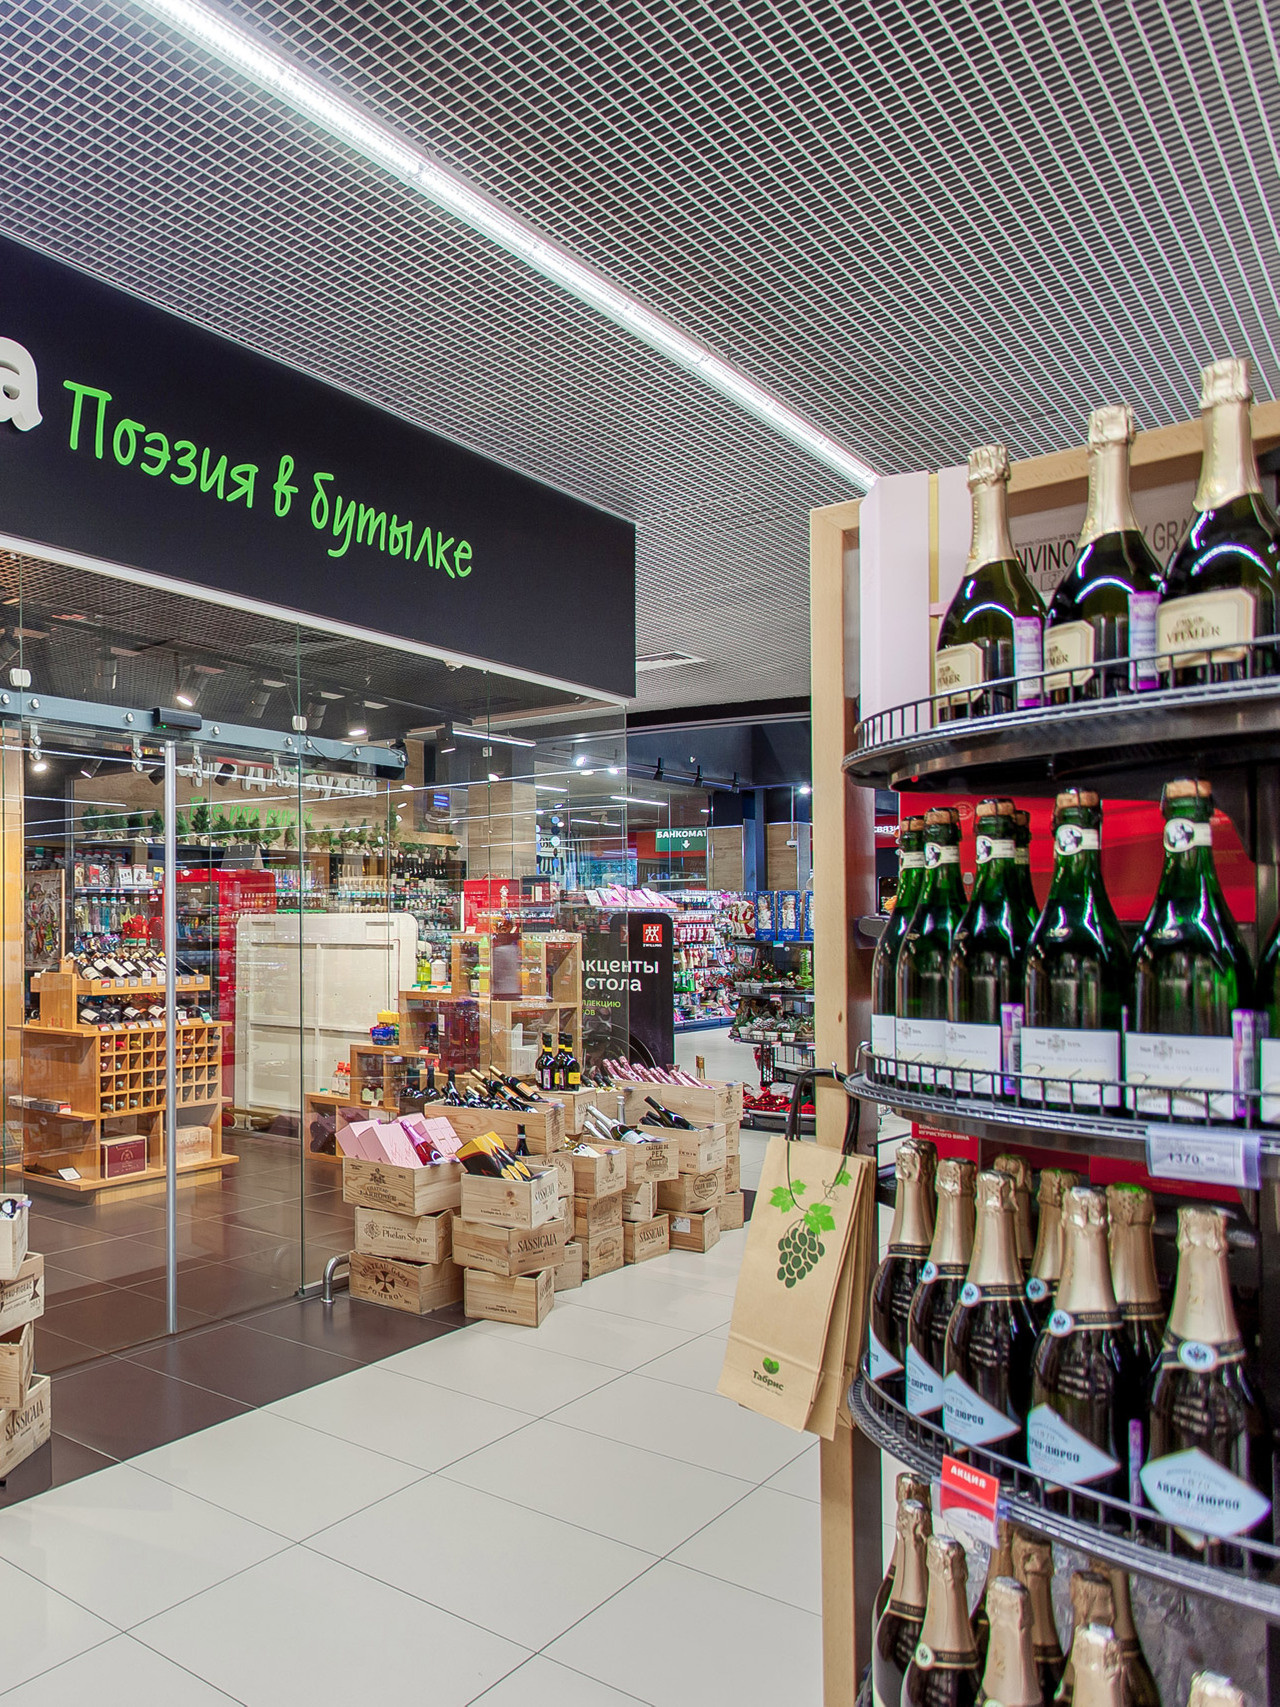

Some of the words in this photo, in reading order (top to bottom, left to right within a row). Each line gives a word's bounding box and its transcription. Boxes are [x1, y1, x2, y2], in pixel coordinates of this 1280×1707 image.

[63, 379, 258, 509] Поэзия
[273, 455, 298, 517] в
[310, 472, 473, 578] бутылке
[585, 977, 642, 991] стола
[517, 1232, 558, 1253] SASSICAIA
[367, 1285, 404, 1300] POMEROL
[752, 1369, 784, 1391] Табрис
[4, 1399, 45, 1442] SASSICAIA
[951, 1465, 987, 1489] АКЦИЯ
